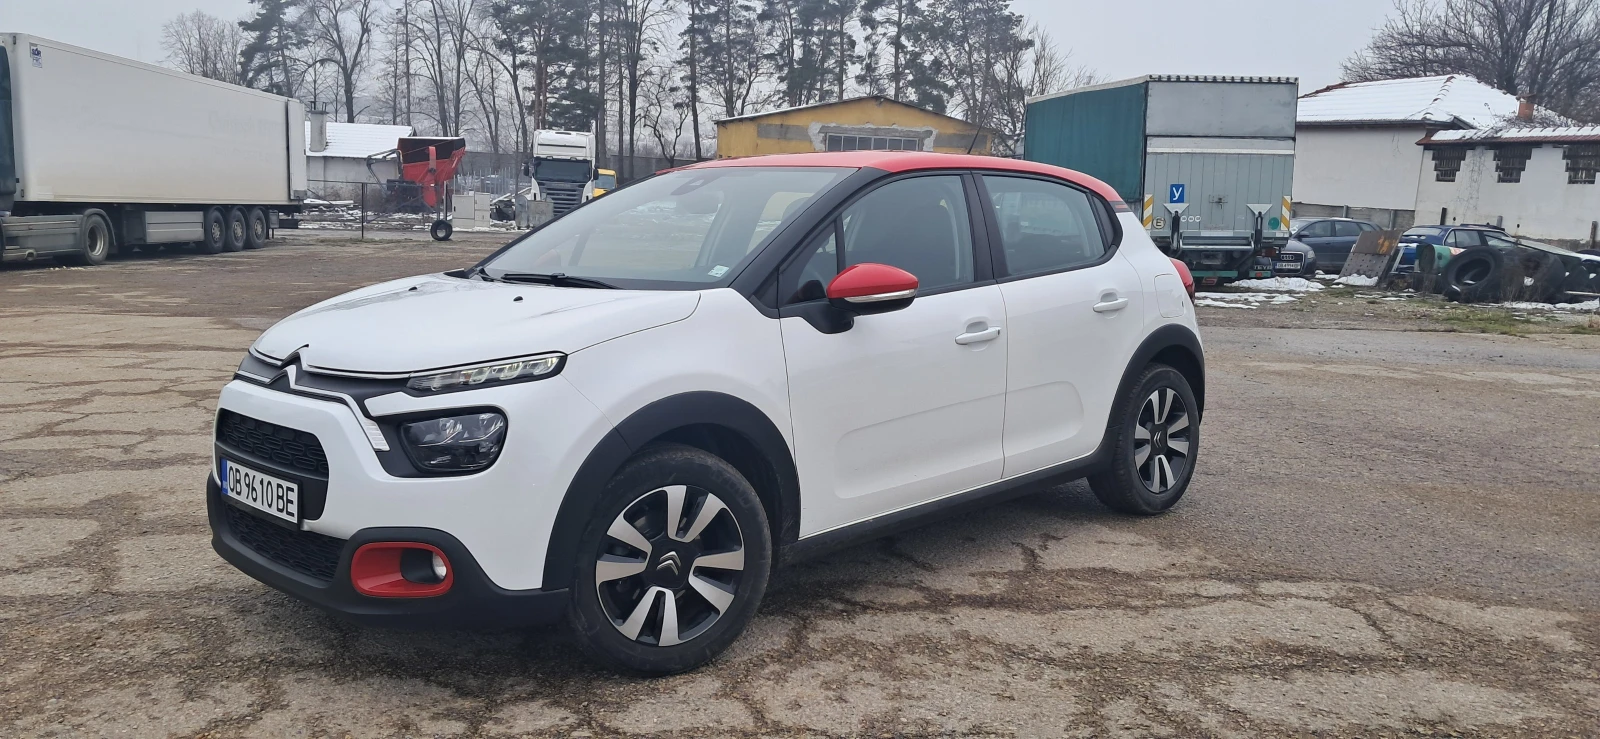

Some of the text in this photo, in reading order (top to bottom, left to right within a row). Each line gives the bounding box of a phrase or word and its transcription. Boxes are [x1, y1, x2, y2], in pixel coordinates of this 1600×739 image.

[228, 466, 295, 517] OB 9610 BE
